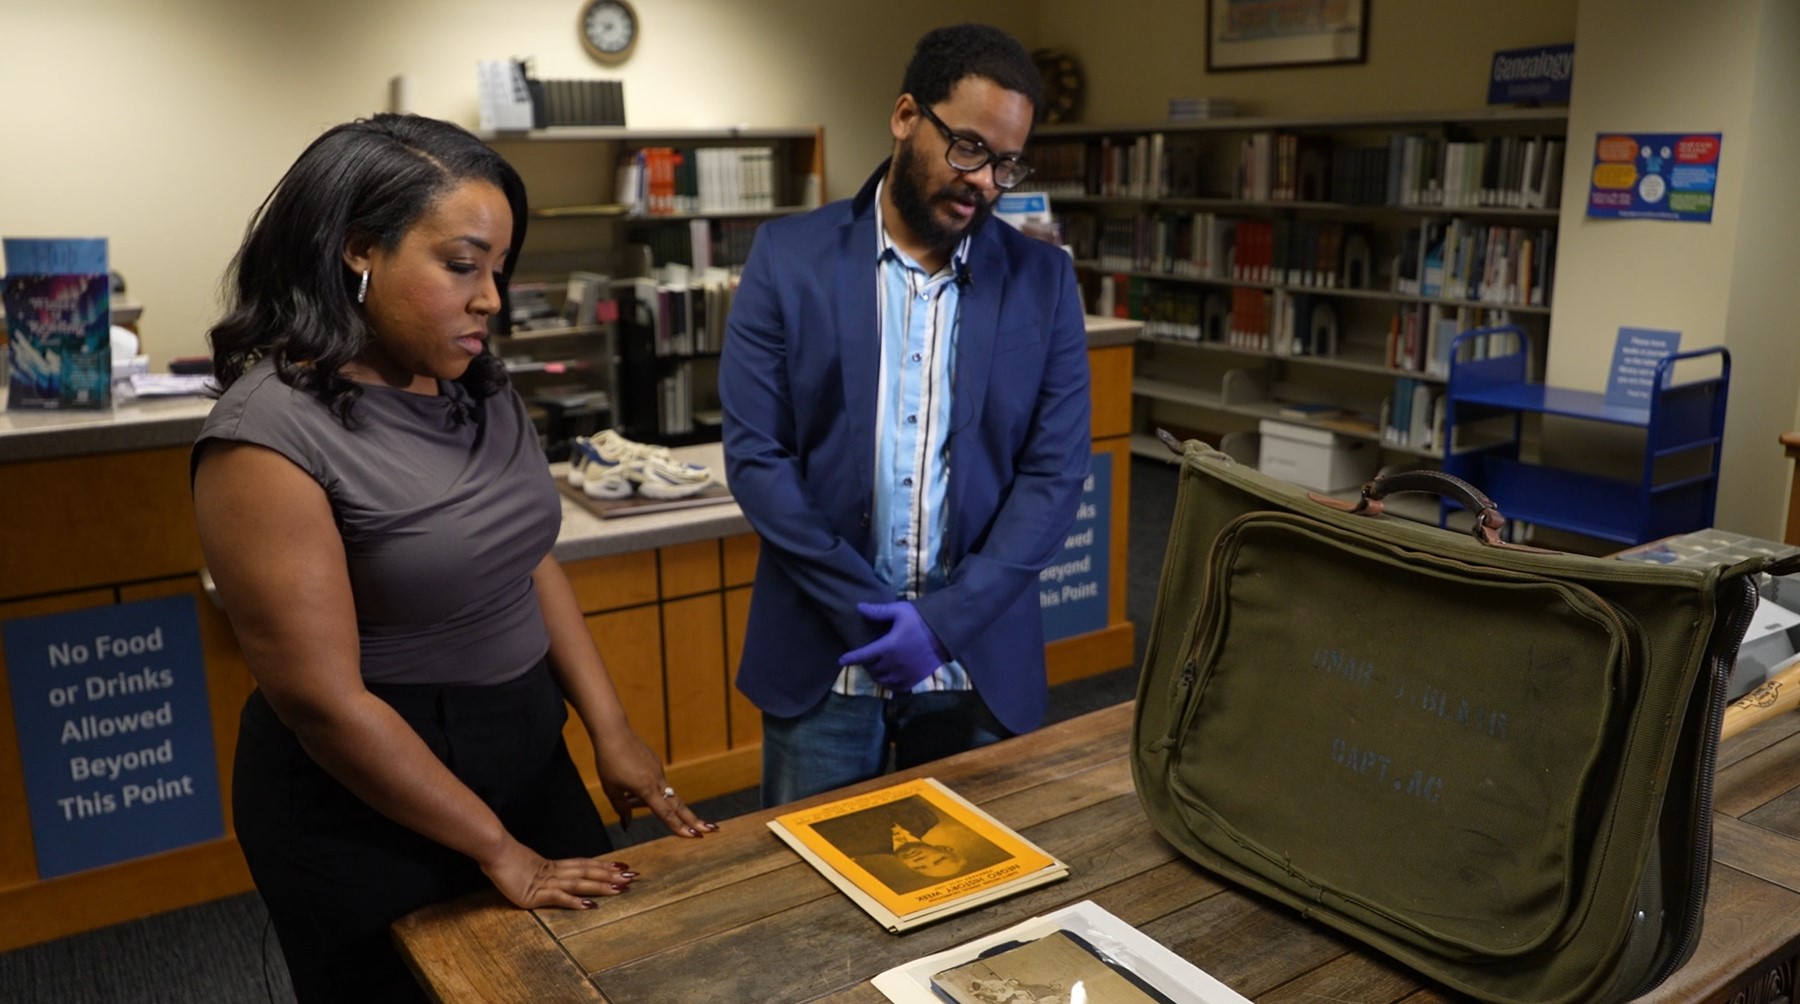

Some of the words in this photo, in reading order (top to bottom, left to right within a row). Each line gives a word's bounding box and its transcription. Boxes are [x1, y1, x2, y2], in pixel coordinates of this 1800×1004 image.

[1494, 49, 1574, 82] Genealogy
[1039, 589, 1060, 608] his
[1062, 581, 1098, 603] Point
[48, 642, 89, 668] No
[95, 626, 163, 660] Food
[49, 682, 78, 707] or
[85, 667, 174, 702] Drinks
[60, 702, 173, 744] Allowed
[70, 739, 173, 781] Beyond
[58, 790, 117, 821] This
[122, 775, 194, 808] Point
